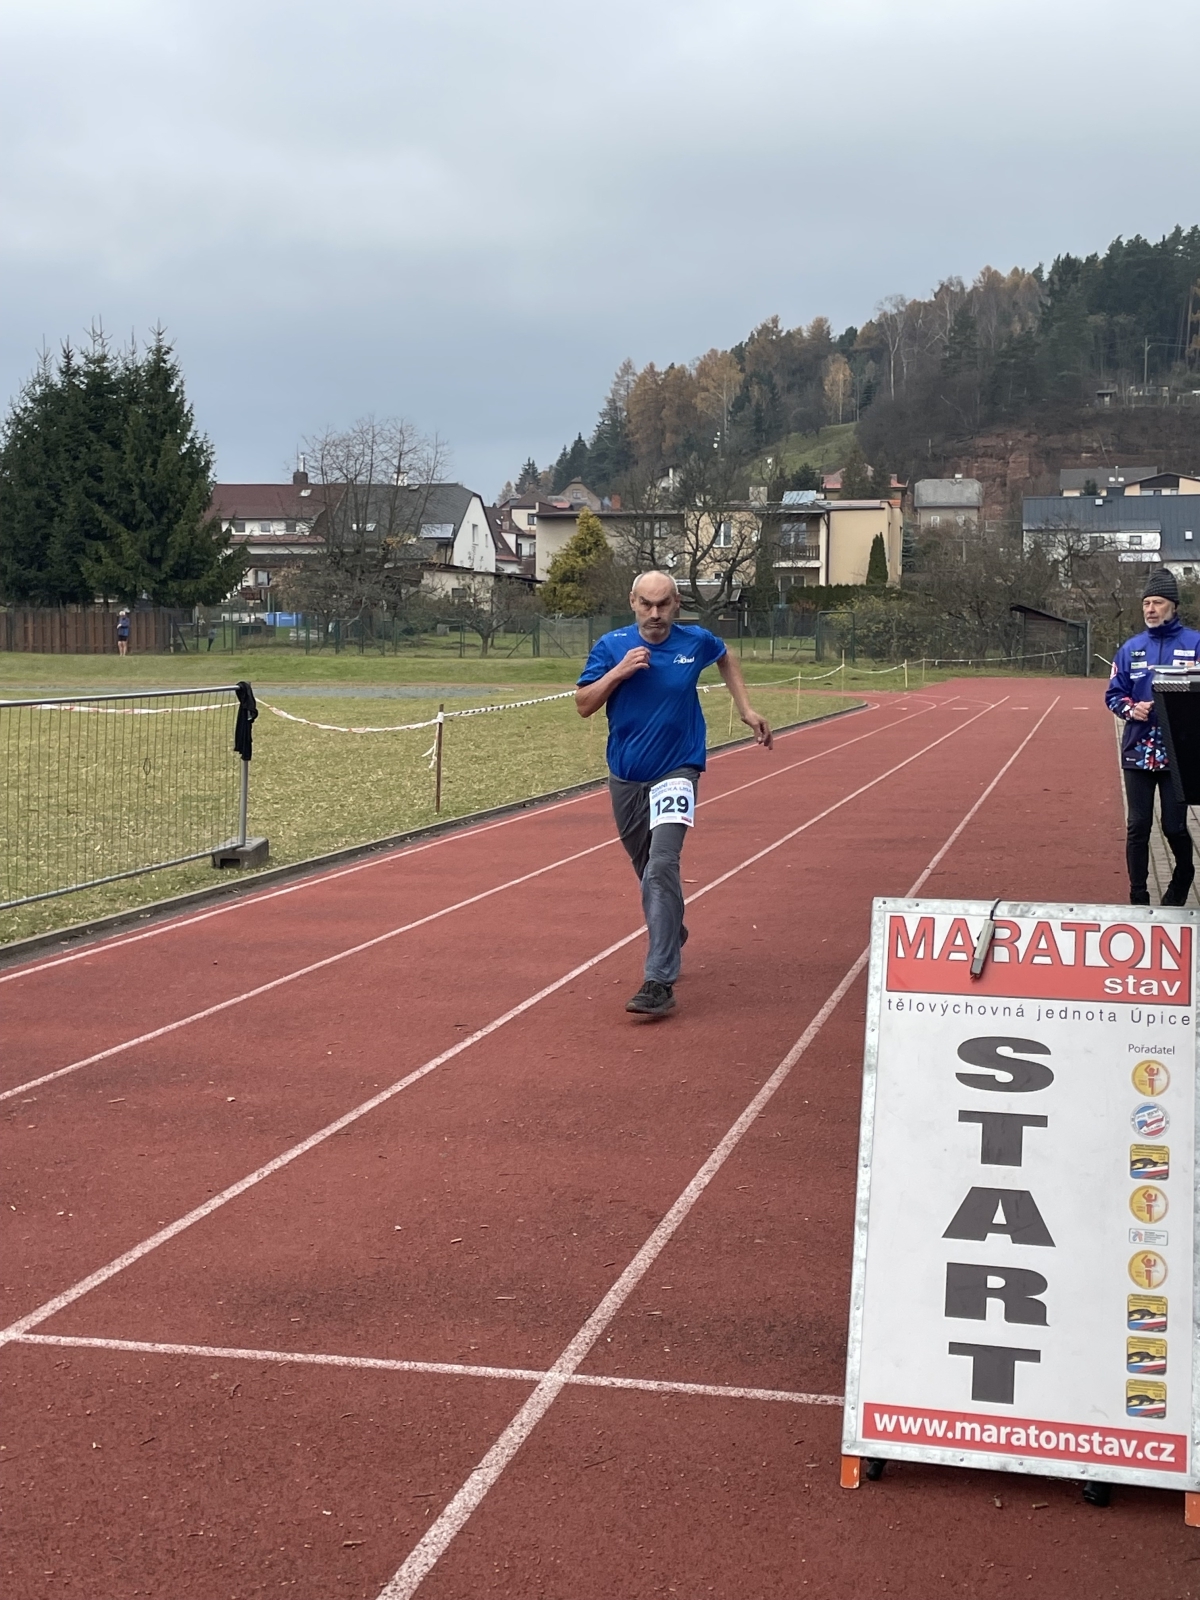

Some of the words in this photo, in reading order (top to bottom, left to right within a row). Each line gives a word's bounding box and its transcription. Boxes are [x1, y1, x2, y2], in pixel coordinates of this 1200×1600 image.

[655, 795, 689, 817] 129
[888, 915, 1192, 970] MARATON
[1103, 974, 1182, 997] stav
[887, 998, 1025, 1018] tělovýchovná
[1036, 1005, 1117, 1023] jednota
[1131, 1007, 1191, 1027] Úpice
[1128, 1043, 1176, 1056] Pořadatel
[941, 1035, 1056, 1405] START
[873, 1412, 1176, 1463] www.maratonstav.cz
